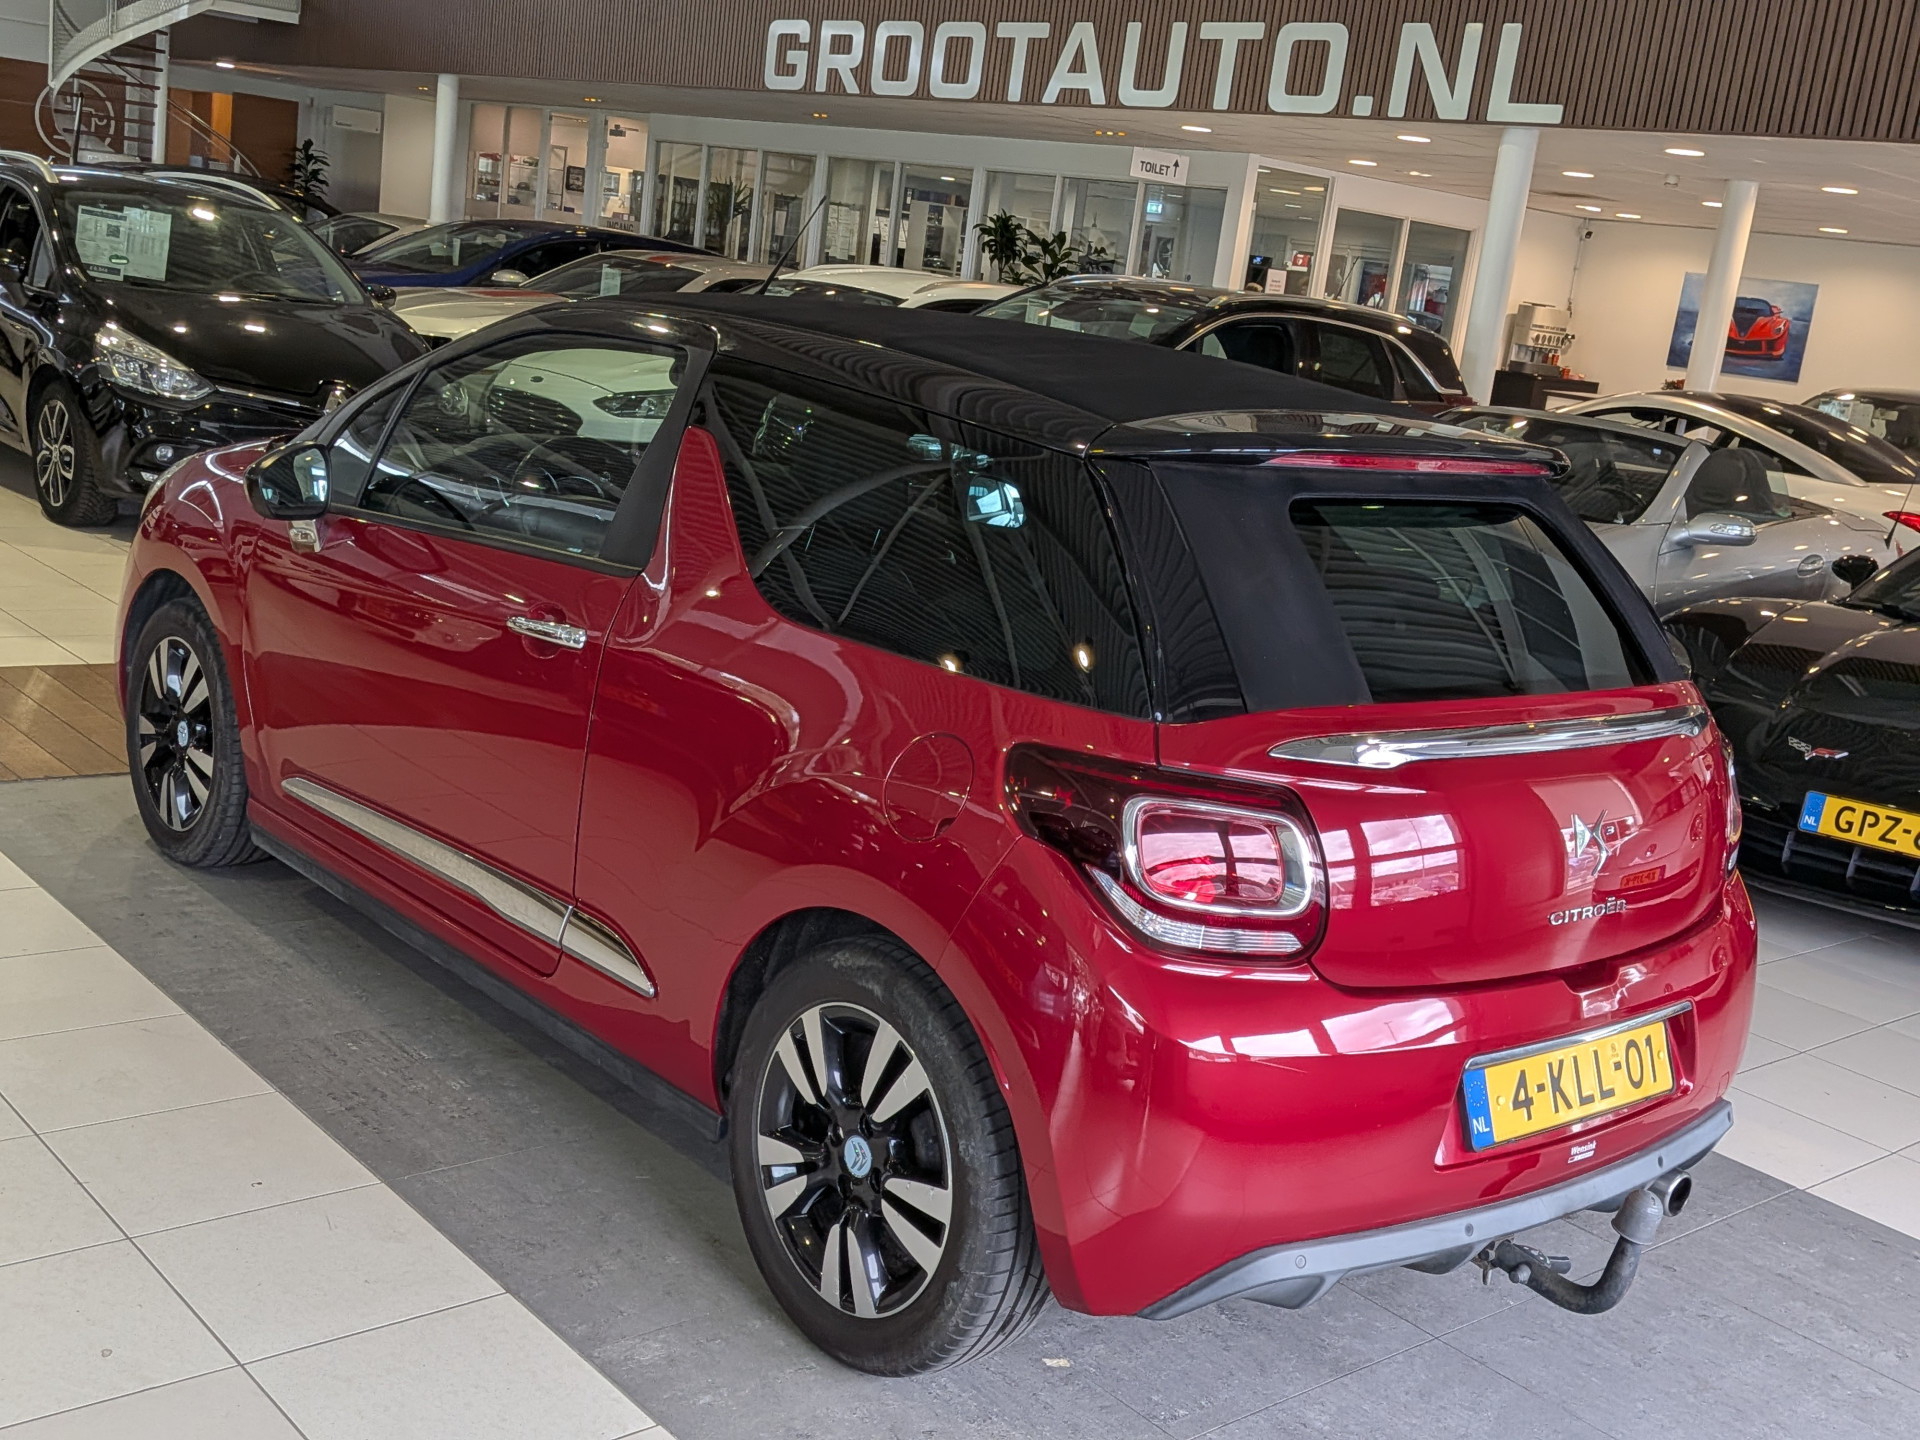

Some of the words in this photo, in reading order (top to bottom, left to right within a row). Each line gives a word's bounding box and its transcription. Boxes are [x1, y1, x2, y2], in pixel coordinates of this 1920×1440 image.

[764, 19, 1564, 124] GROOTAUTO.NL
[1140, 160, 1171, 177] TOILET
[1803, 814, 1817, 826] NL
[1605, 825, 1616, 836] 3
[1511, 1034, 1657, 1122] 4-KLL-01
[1472, 1117, 1490, 1135] NL
